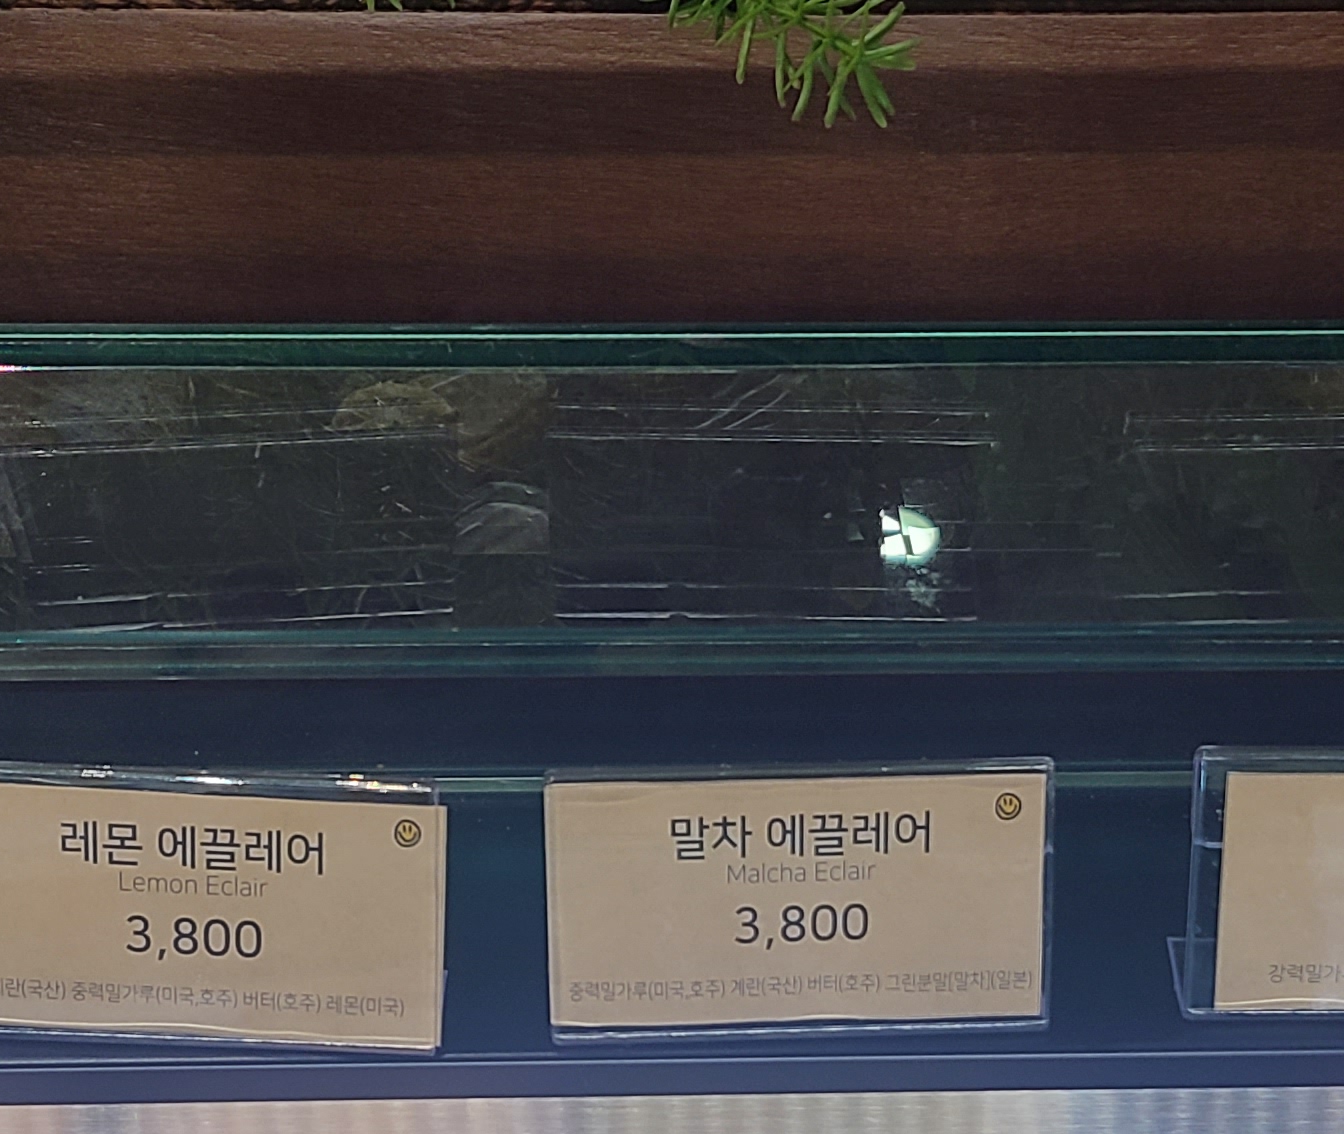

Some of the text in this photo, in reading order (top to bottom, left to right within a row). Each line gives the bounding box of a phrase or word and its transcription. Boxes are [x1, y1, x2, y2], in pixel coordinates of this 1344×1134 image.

[60, 821, 324, 875] 레몬 에끌레어
[670, 810, 931, 860] 말차 에끌레어
[119, 871, 268, 897] Lemon Eclair
[727, 860, 876, 884] Malcha Eclair
[125, 914, 263, 960] 3,800
[734, 903, 869, 950] 3,800
[72, 981, 238, 1008] 중력밀가루(미국,호주)
[243, 991, 321, 1013] 버터(호주)
[326, 995, 404, 1017] 레몬(미국)
[730, 975, 802, 998] 계란(국산)
[807, 973, 880, 993] 버터(호주)
